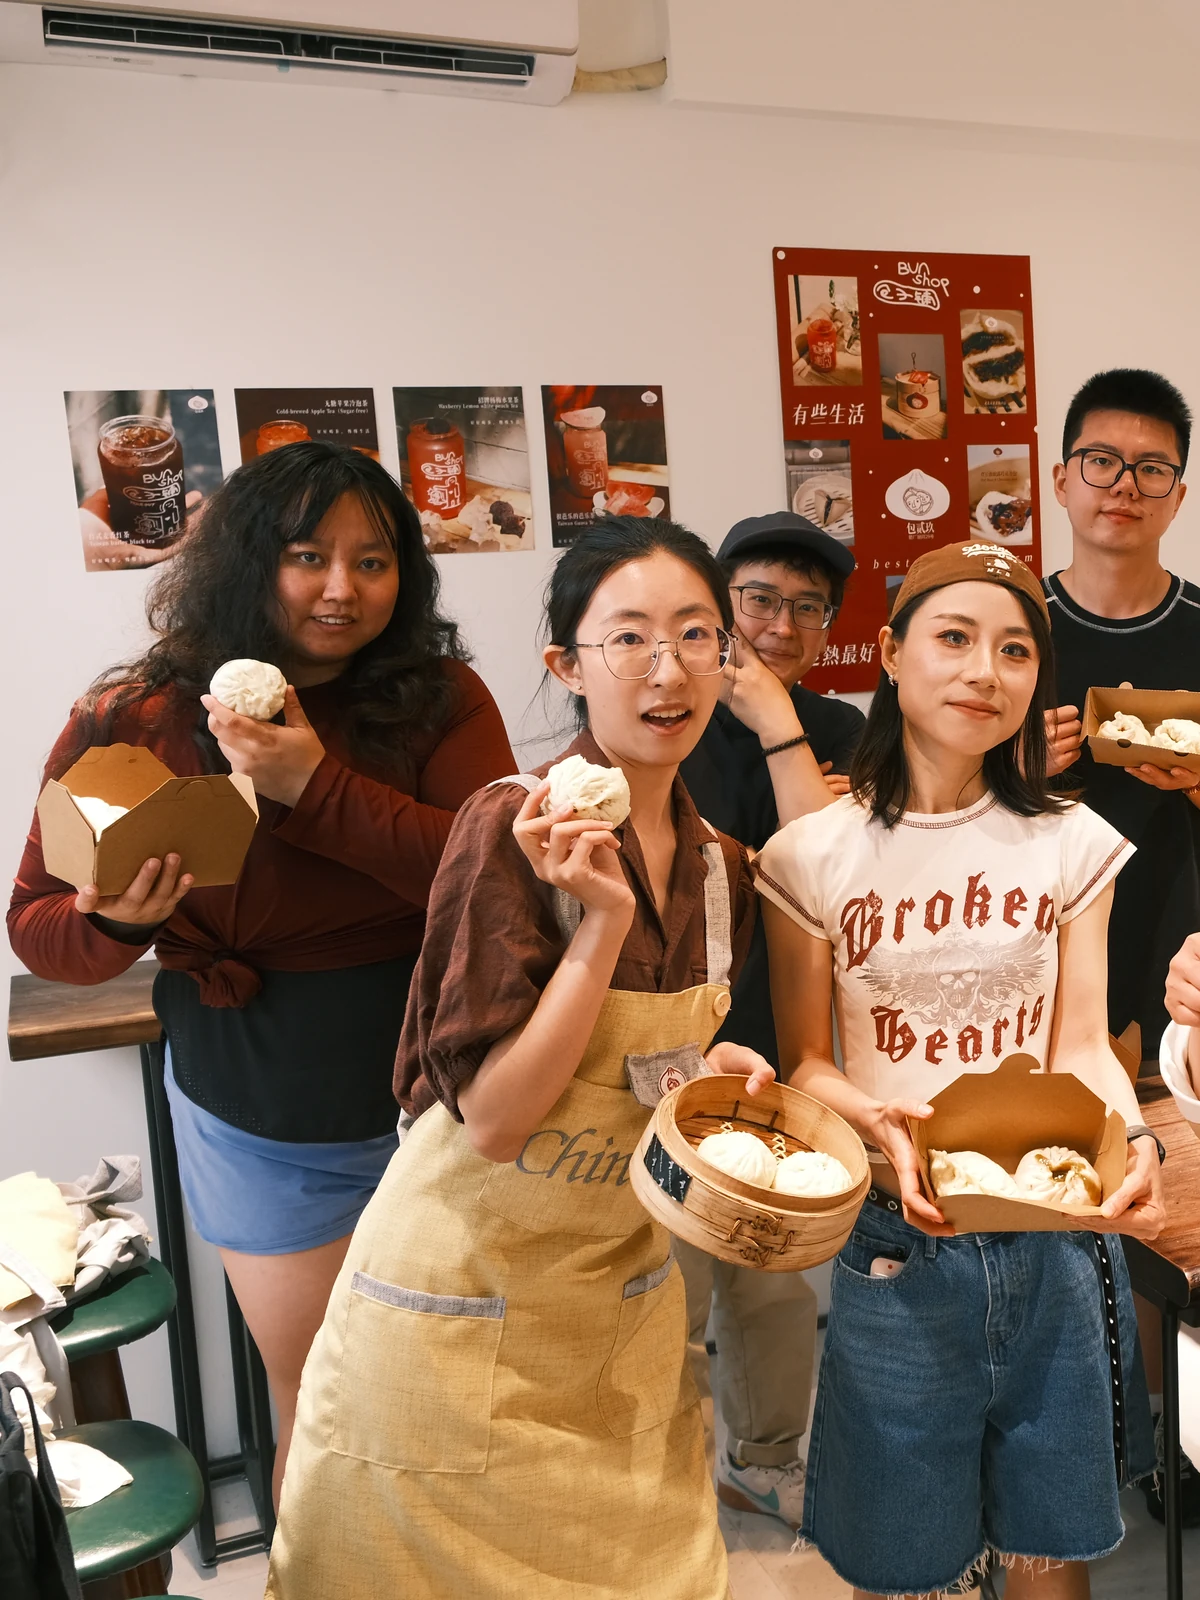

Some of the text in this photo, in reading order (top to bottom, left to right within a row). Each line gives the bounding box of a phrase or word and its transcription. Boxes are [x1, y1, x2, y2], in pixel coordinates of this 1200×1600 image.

[912, 271, 949, 297] shop
[792, 402, 866, 426] 有些生活
[812, 643, 876, 667] 熱最好
[840, 871, 1054, 972] Broken
[870, 993, 1045, 1065] Hearts
[516, 1128, 633, 1187] Chin
